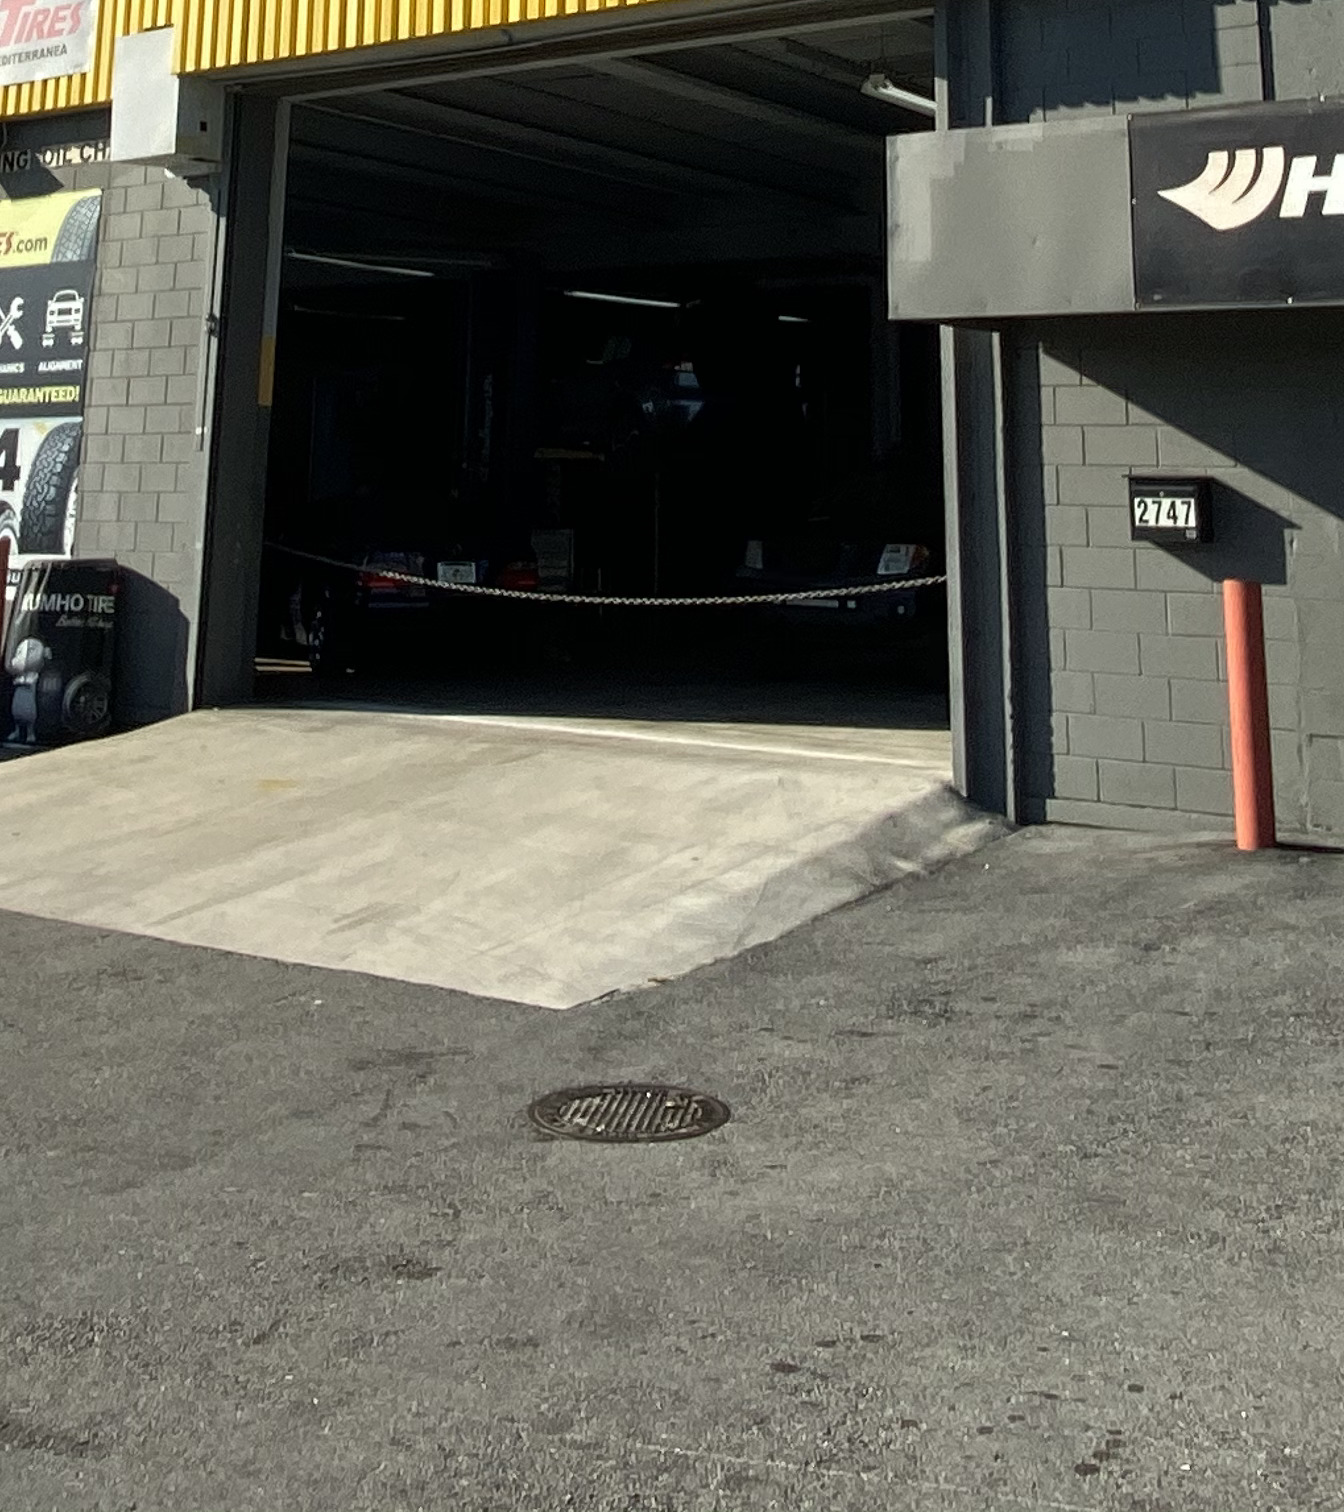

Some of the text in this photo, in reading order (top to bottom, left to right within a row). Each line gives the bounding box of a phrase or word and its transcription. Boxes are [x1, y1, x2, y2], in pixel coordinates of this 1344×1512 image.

[38, 359, 84, 373] ALIGNMENT
[1136, 498, 1193, 526] 2747
[87, 592, 116, 615] TIRE
